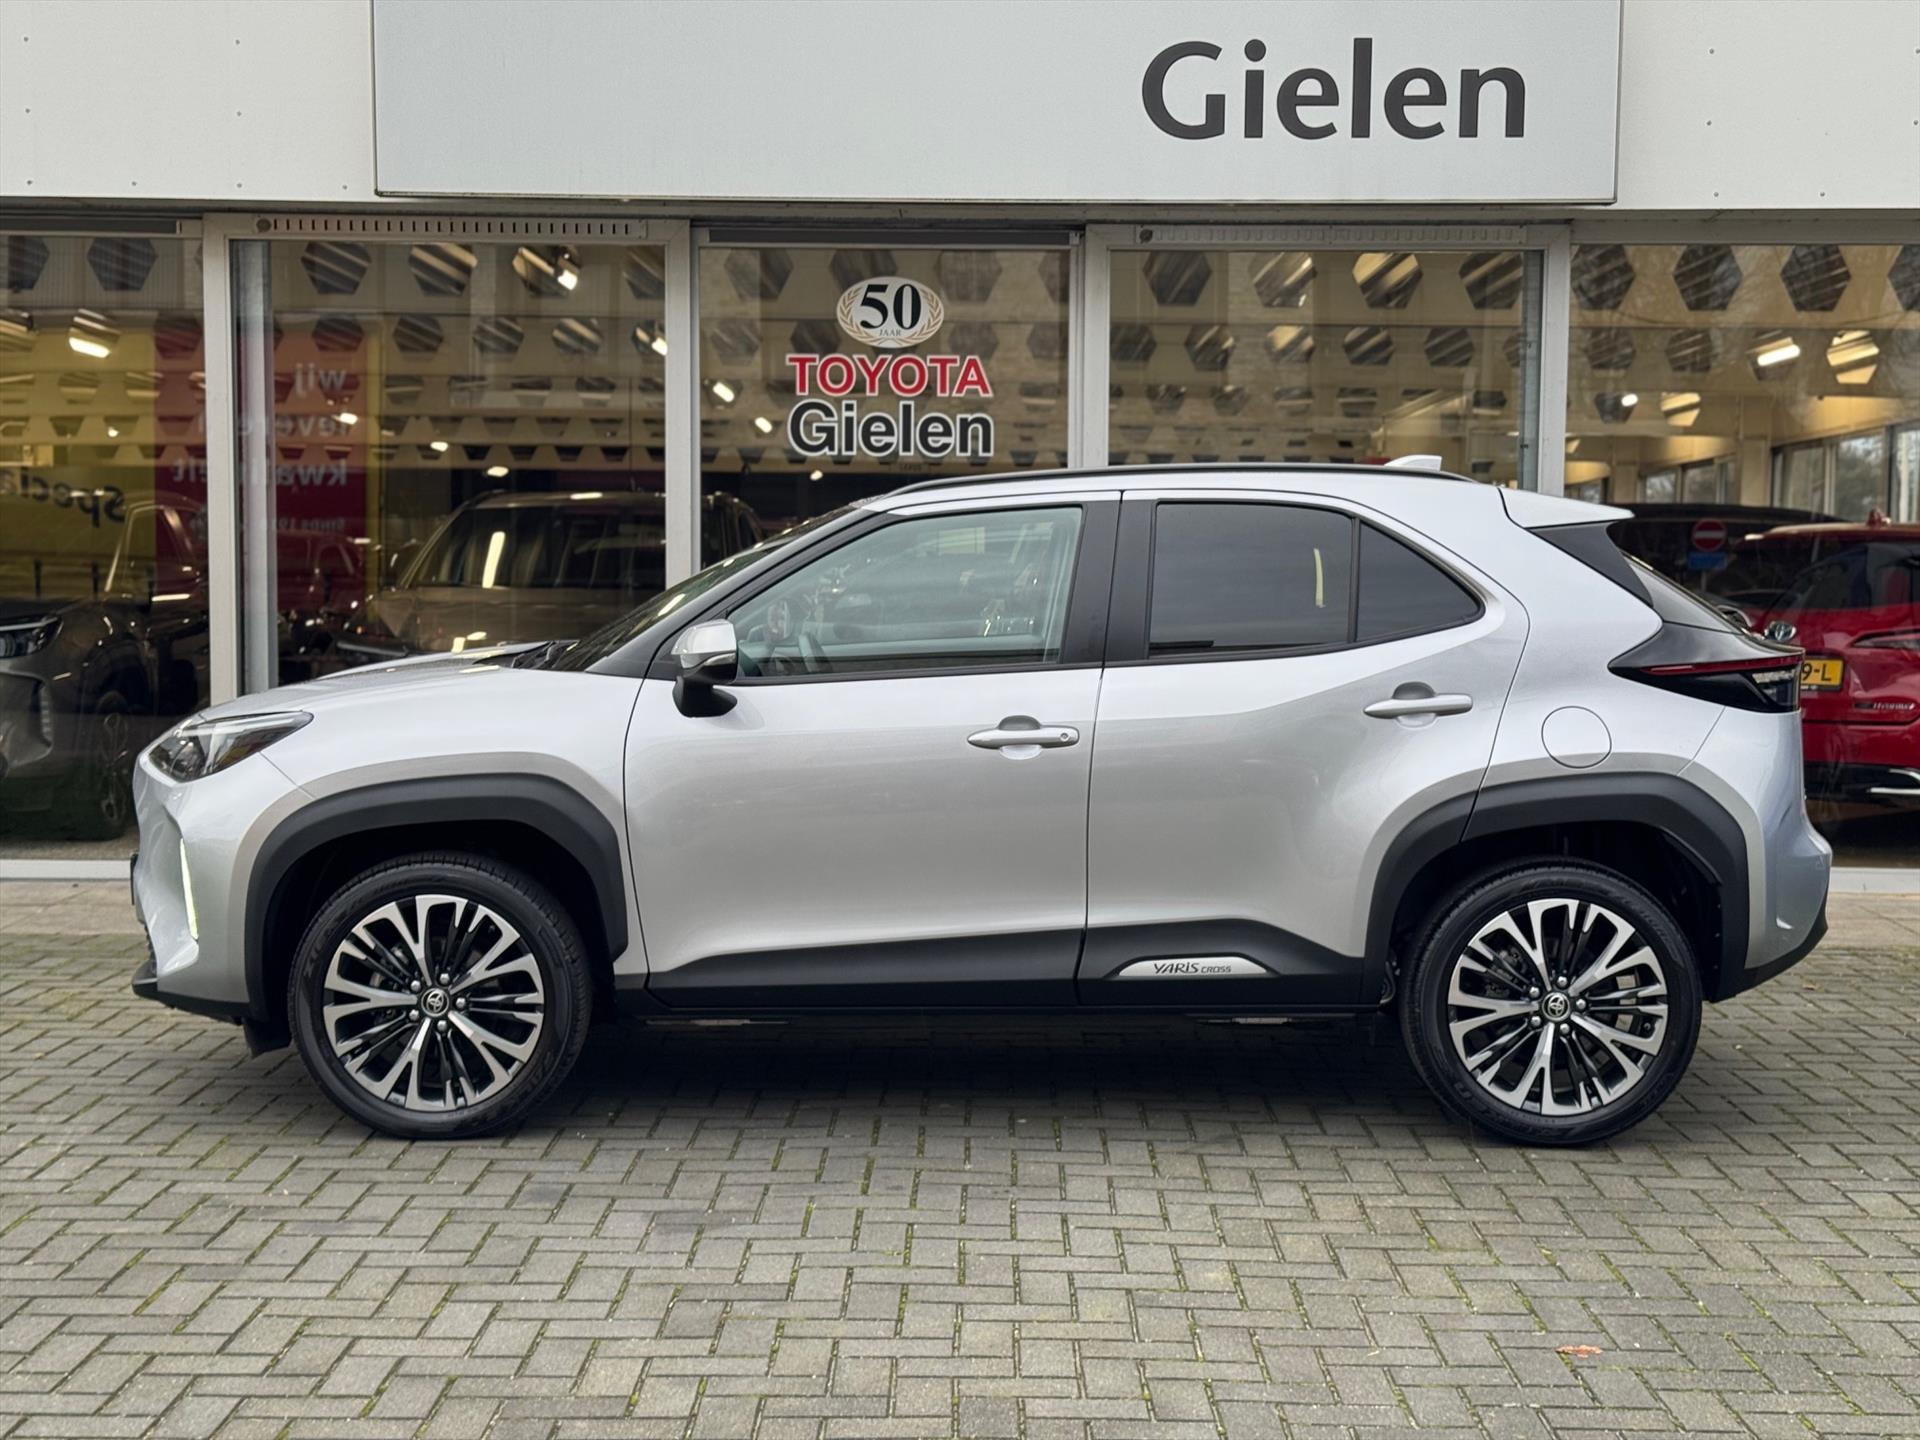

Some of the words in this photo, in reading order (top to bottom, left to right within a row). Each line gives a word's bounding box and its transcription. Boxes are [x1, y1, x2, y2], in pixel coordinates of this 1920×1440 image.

[1142, 37, 1526, 140] Gielen
[860, 283, 922, 330] 50
[879, 329, 901, 337] JAAR
[786, 354, 993, 397] TOYOTA
[787, 398, 994, 457] Gielen
[1201, 965, 1231, 974] CROSS
